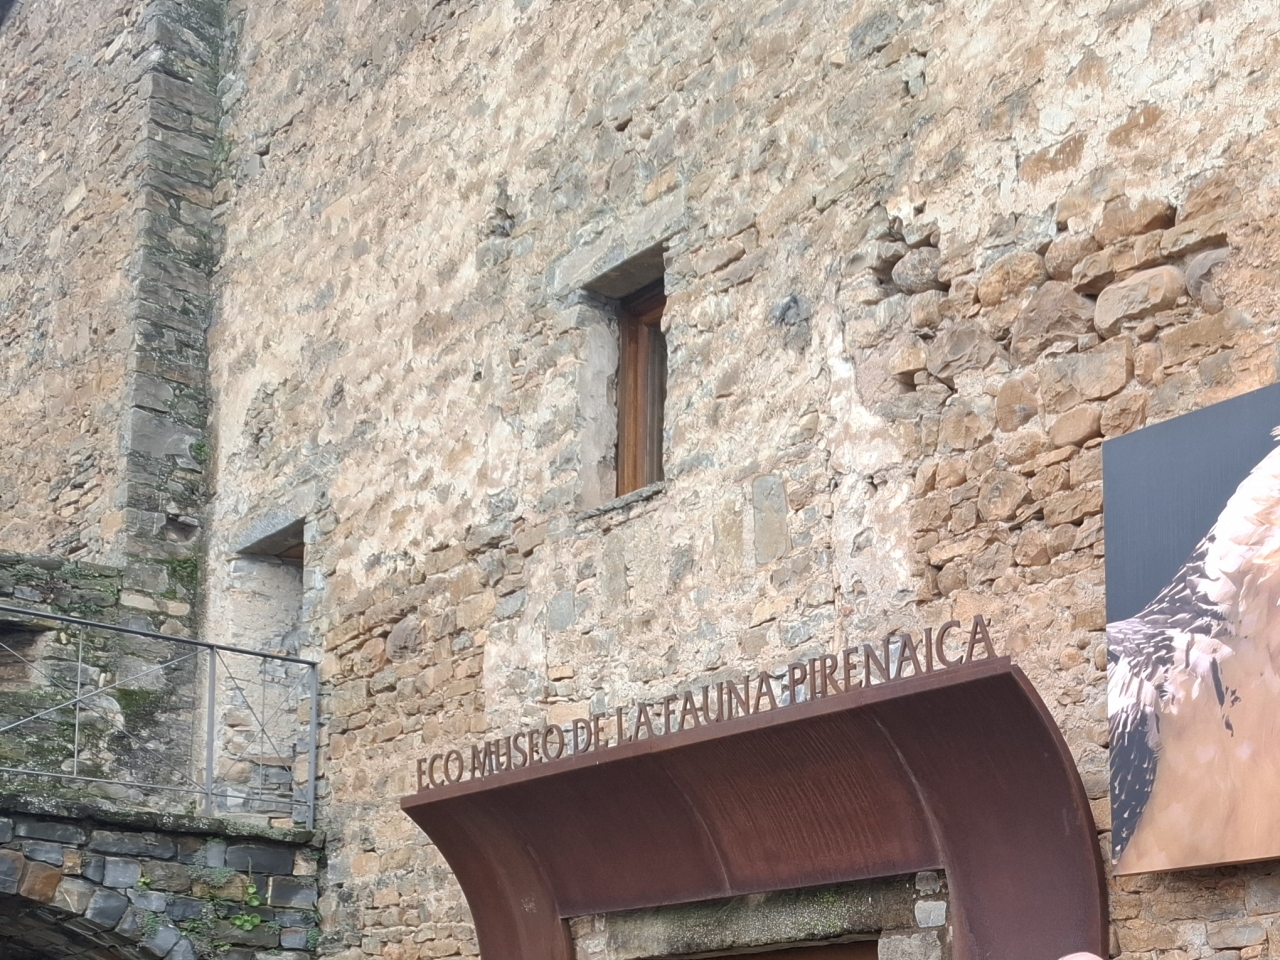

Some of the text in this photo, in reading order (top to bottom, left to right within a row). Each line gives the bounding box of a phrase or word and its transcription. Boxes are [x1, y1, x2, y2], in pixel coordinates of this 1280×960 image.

[416, 614, 997, 792] ECO MUSEO DE LA FAUNA PIRENAICA
